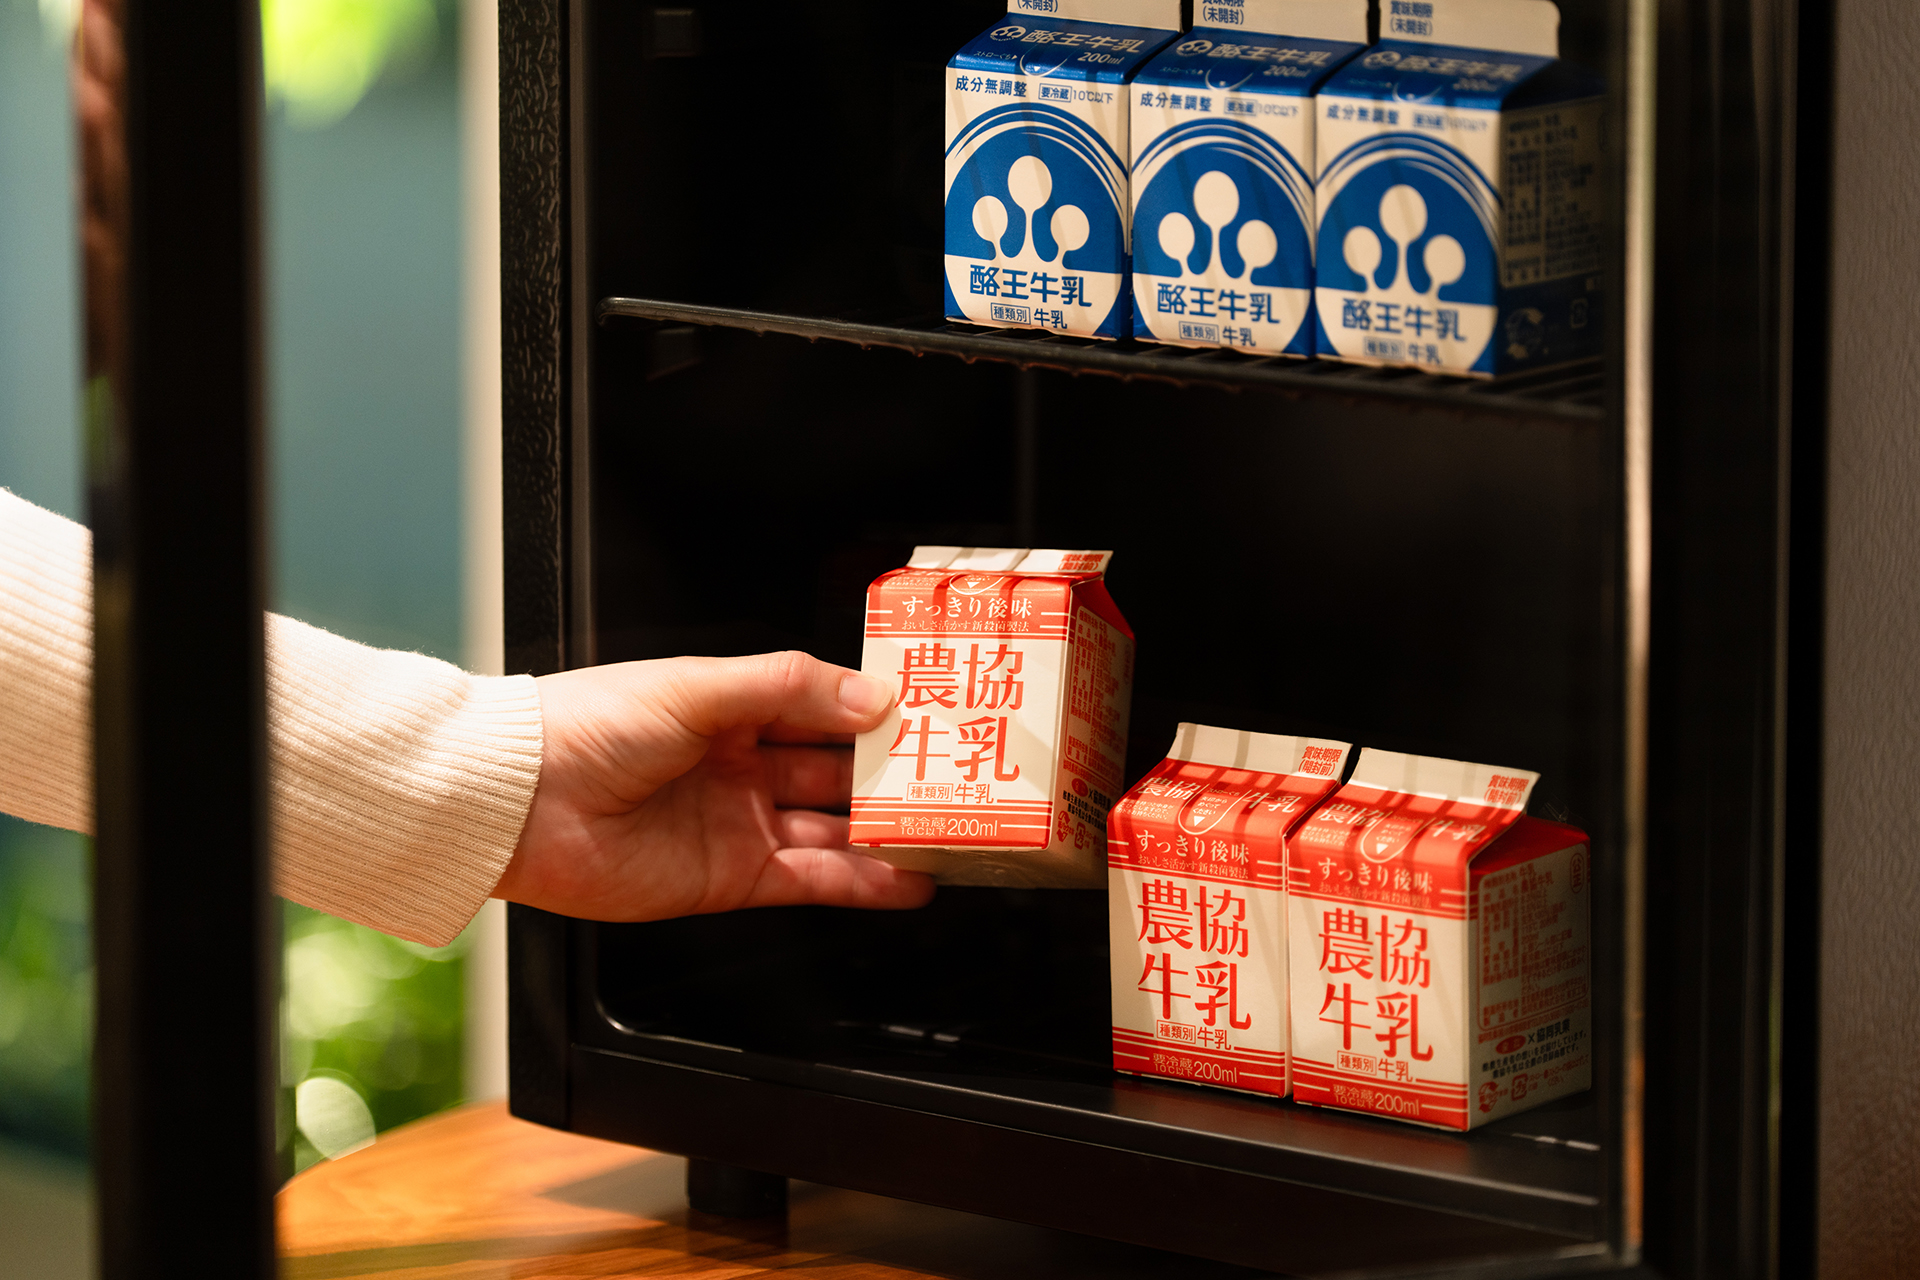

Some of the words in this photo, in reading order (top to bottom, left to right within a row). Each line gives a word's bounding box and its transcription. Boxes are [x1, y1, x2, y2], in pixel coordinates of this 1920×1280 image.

[1202, 5, 1244, 25] (未開封)
[1020, 29, 1145, 53] 酪王牛乳
[1077, 52, 1125, 66] 200ml
[1207, 43, 1331, 67] 酪王牛乳
[955, 76, 1027, 98] 成分無調整
[1041, 85, 1070, 100] 要冷蔵
[1140, 92, 1212, 112] 成分無調整
[969, 264, 1092, 307] 酪王牛乳
[1157, 283, 1280, 324] 酪王牛乳
[994, 306, 1028, 323] 種類別
[1034, 308, 1067, 329] 牛乳
[1342, 298, 1467, 342] 酪王牛乳
[1182, 324, 1217, 341] 種類別
[1222, 326, 1256, 347] 牛乳
[1408, 342, 1442, 365] 牛乳
[902, 596, 1032, 619] すっきり後味
[901, 620, 1029, 632] おいしさ活かす新殺菌製法
[894, 643, 1024, 710] 農協
[889, 716, 1020, 782] 牛乳
[1302, 745, 1342, 762] 賞味期限
[1298, 759, 1335, 776] (開封前)
[910, 785, 950, 799] 種類別
[954, 783, 994, 804] 牛乳
[1488, 774, 1529, 792] 賞味期限
[1135, 777, 1201, 800] 農協
[1242, 792, 1302, 813] 牛乳
[900, 816, 946, 827] 要冷蔵
[1317, 803, 1384, 827] 農協
[947, 818, 997, 836] 200ml
[1136, 830, 1249, 865] すっきり後味
[1318, 857, 1433, 893] すっきり後味
[1137, 879, 1249, 958] 農協
[1319, 908, 1430, 989] 農協
[1137, 952, 1252, 1030] 牛乳
[1319, 983, 1433, 1062] 牛乳
[1160, 1024, 1193, 1041] 種類別
[1197, 1026, 1231, 1050] 牛乳
[1153, 1053, 1192, 1068] 要冷蔵
[1194, 1061, 1237, 1083] 200ml
[1340, 1054, 1374, 1073] 種類別
[1378, 1058, 1413, 1082] 牛乳
[1375, 1092, 1420, 1116] 200ml
